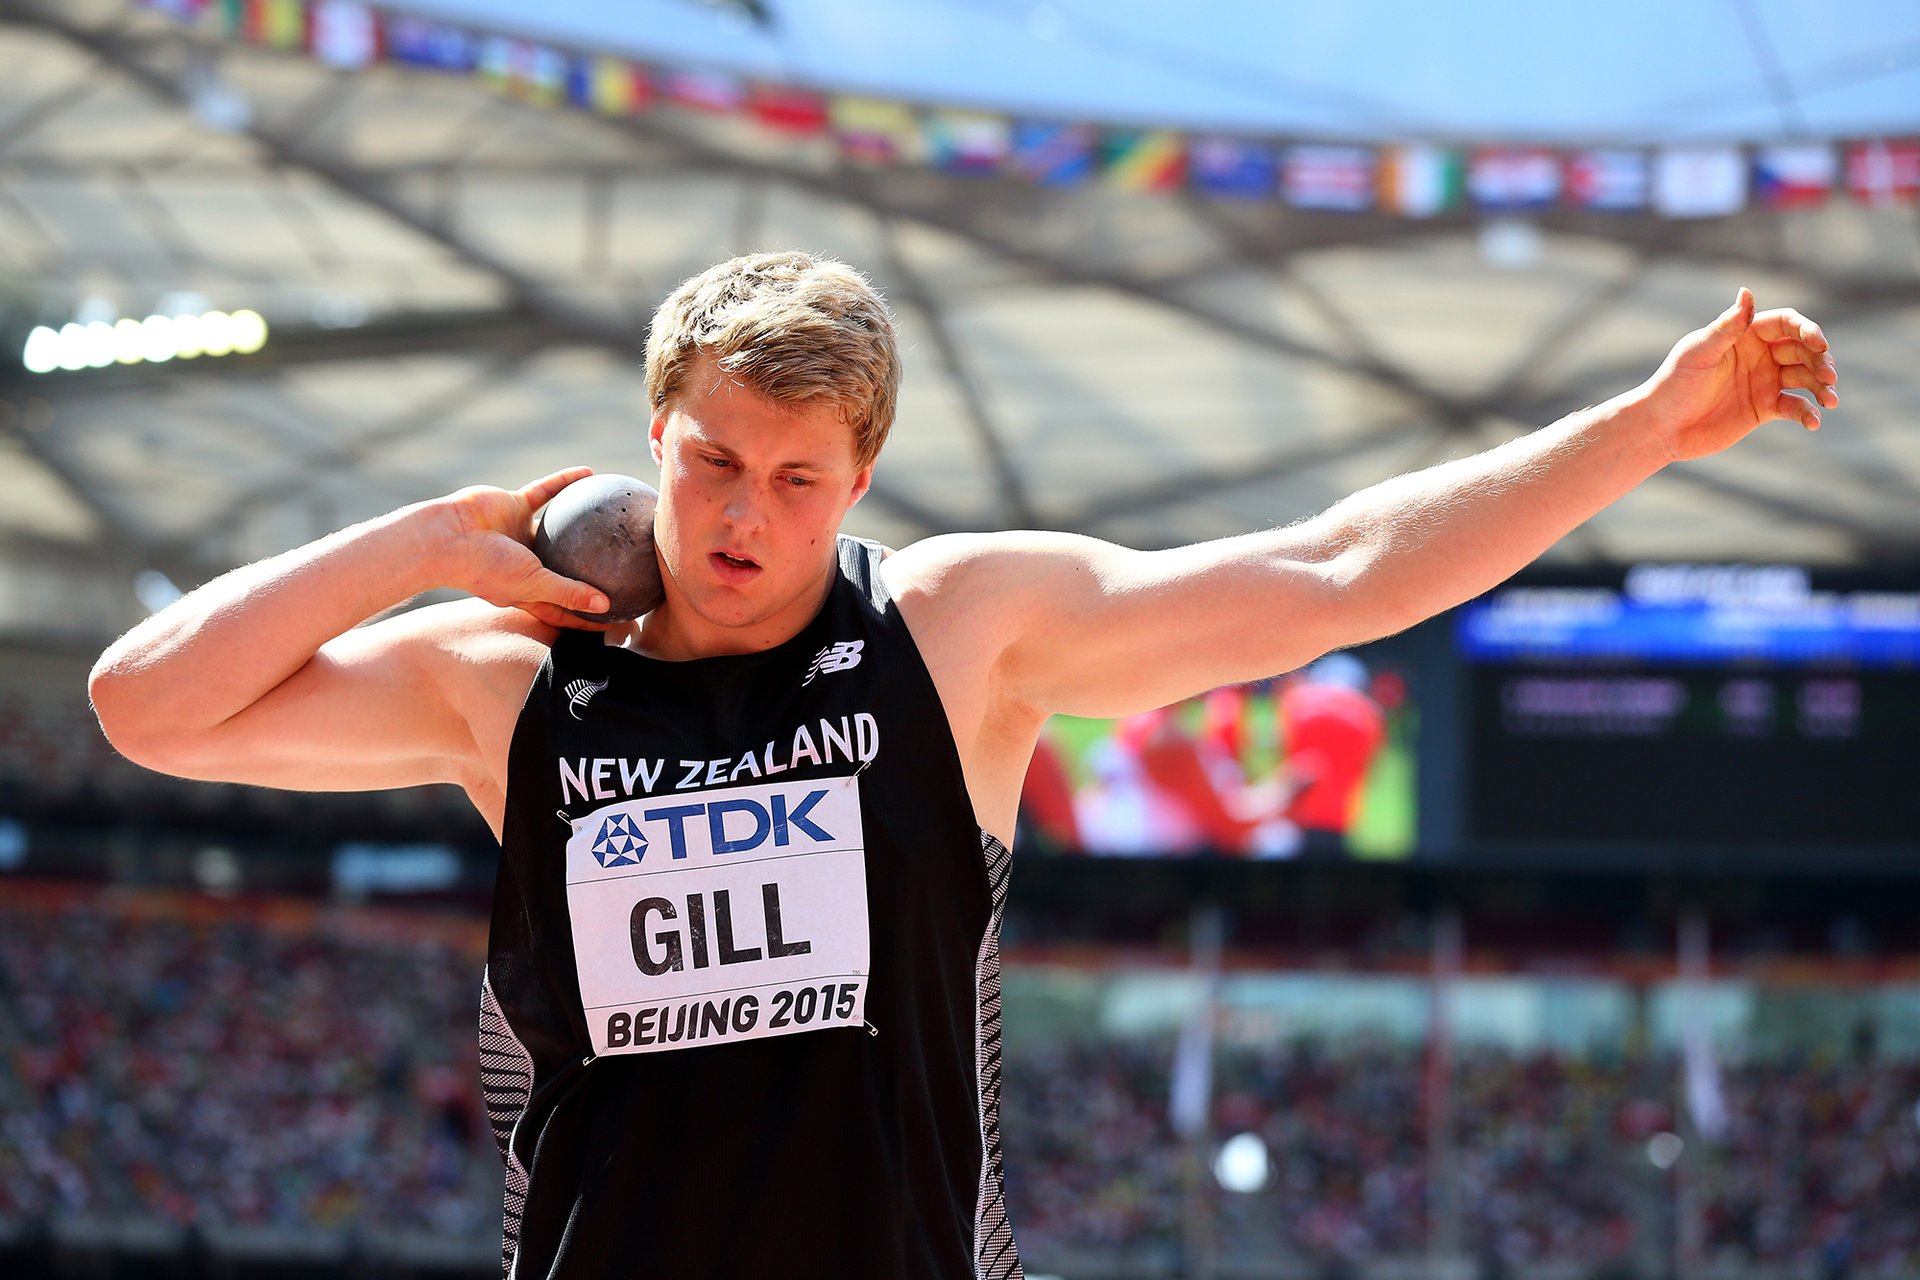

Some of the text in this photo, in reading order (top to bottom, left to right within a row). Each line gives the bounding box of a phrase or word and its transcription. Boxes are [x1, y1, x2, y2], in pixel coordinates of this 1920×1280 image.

[558, 712, 880, 805] NEW ZEALAND
[644, 790, 836, 860] TDK
[629, 882, 812, 977] GILL
[607, 983, 860, 1048] BEIJING 2015
